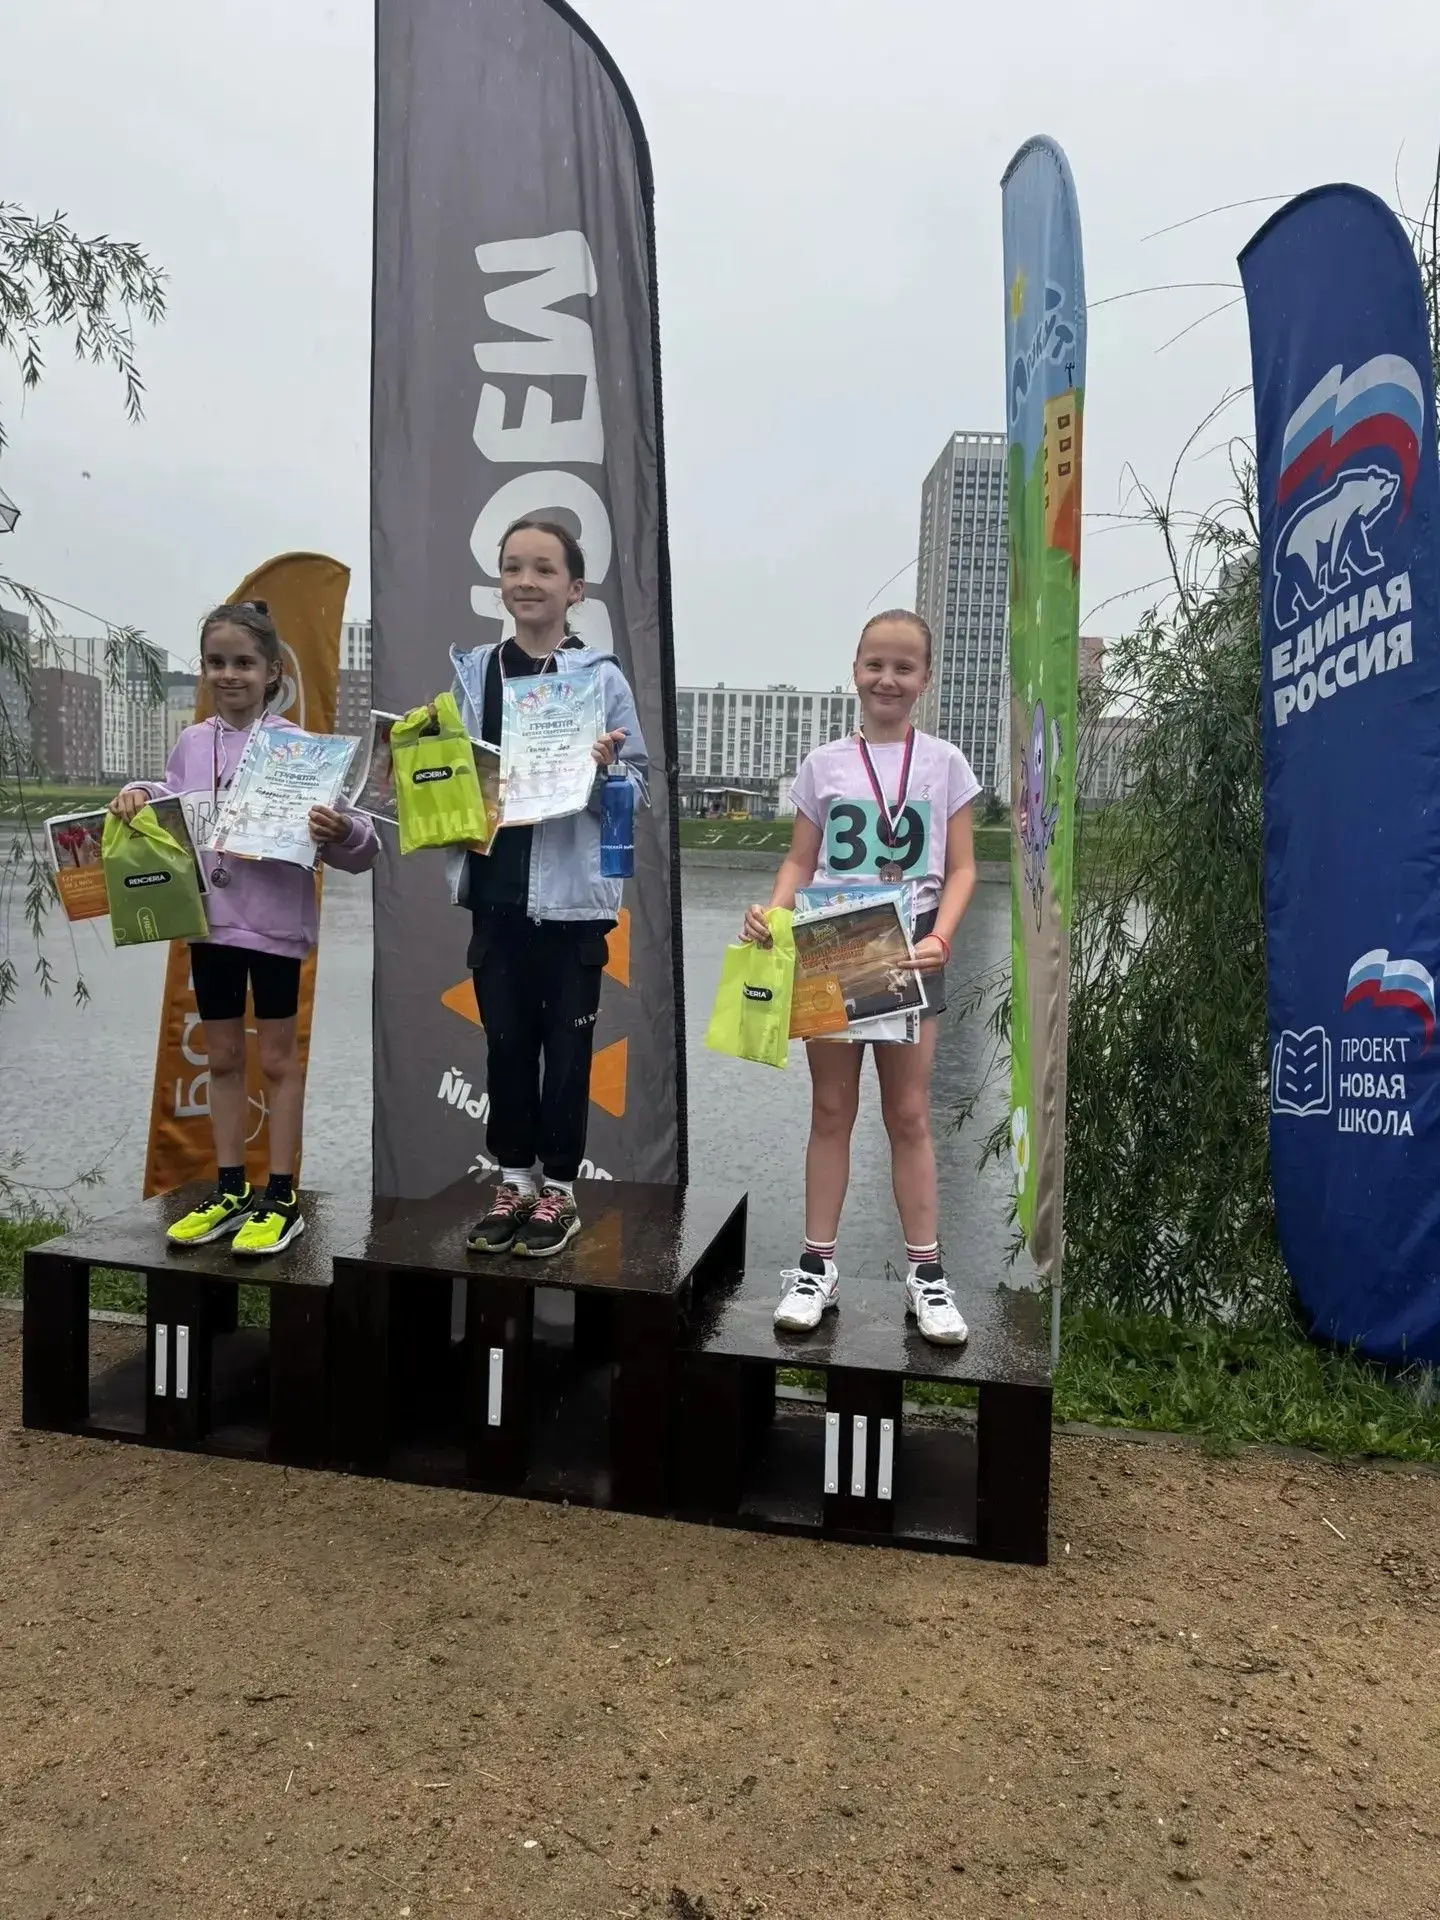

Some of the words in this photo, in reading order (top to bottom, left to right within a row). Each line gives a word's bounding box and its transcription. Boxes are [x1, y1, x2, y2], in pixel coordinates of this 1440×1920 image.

[1272, 571, 1412, 681] ЕДИНАЯ
[1274, 621, 1413, 727] РОССИЯ
[828, 803, 925, 871] 39
[1340, 1037, 1410, 1063] ПРОЕКТ
[1339, 1073, 1406, 1100] НОВАЯ
[1337, 1107, 1414, 1137] ШКОЛА
